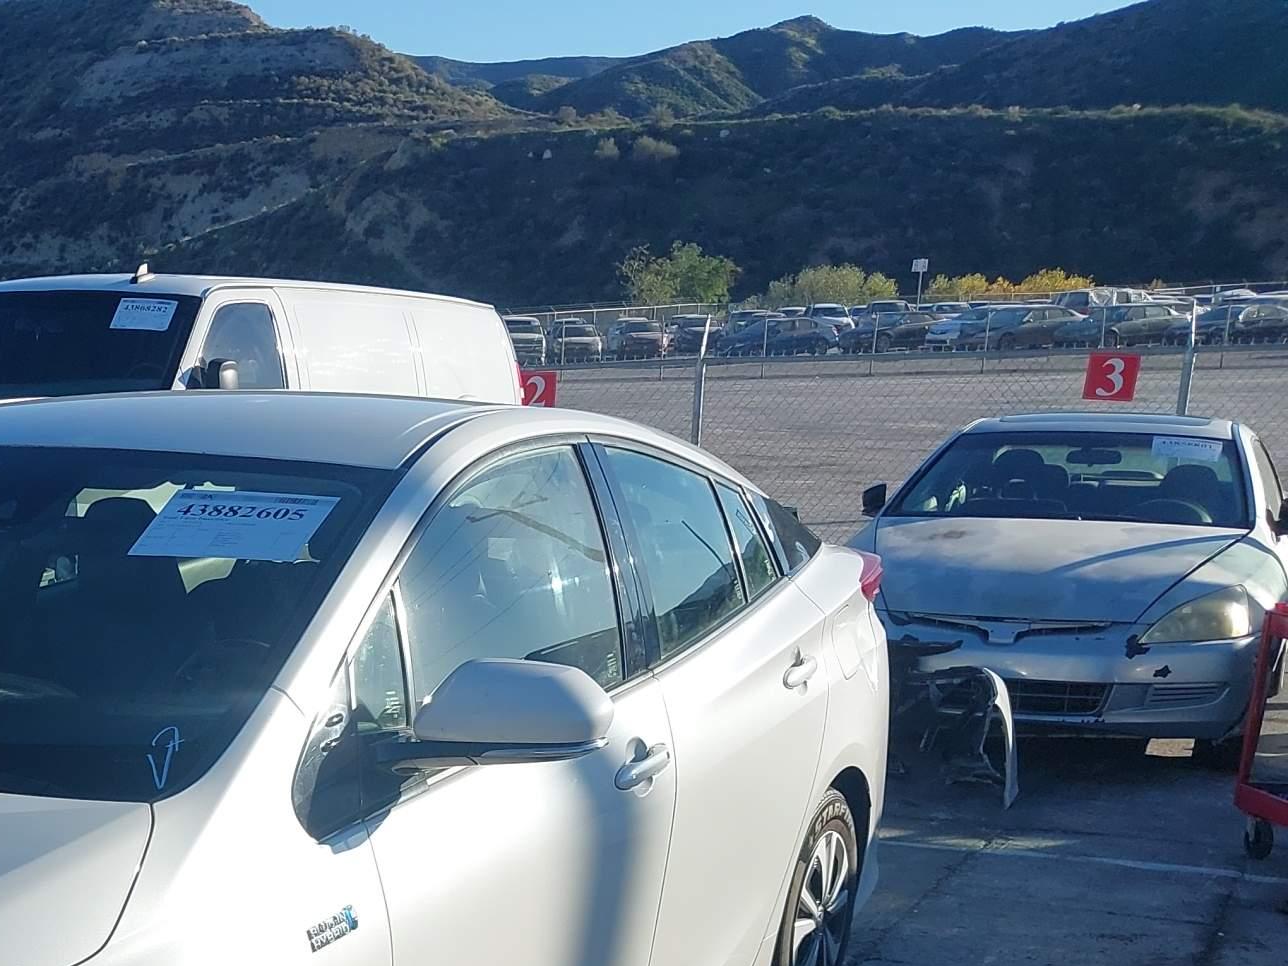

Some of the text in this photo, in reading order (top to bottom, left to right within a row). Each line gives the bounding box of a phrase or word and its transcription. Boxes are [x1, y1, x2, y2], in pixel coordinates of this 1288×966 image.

[526, 375, 546, 407] 2
[1095, 357, 1125, 397] 3
[177, 503, 309, 521] 43882605
